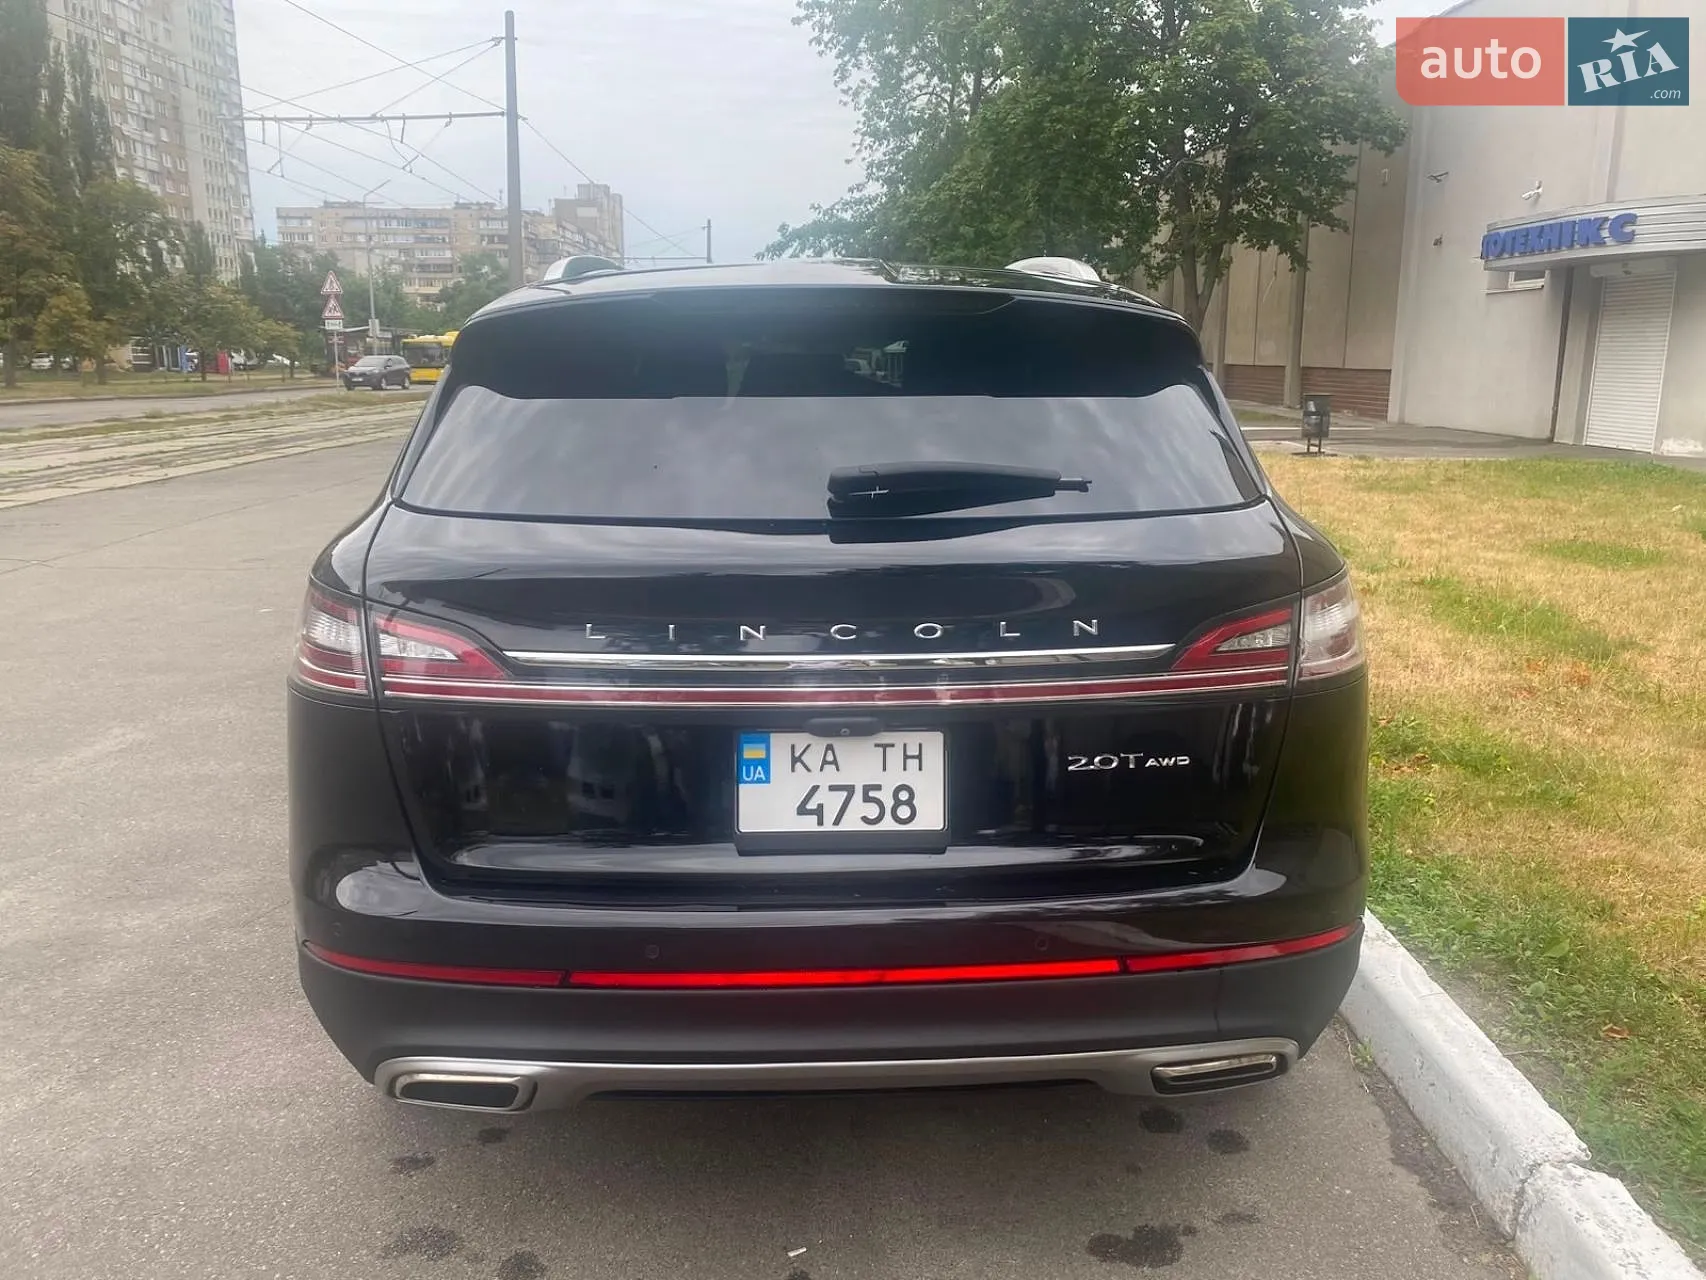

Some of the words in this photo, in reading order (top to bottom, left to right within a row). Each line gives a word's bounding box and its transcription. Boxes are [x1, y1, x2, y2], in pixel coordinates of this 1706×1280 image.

[585, 619, 1099, 641] LINCOLN
[790, 743, 840, 773] KA
[874, 742, 923, 772] TH
[1145, 756, 1190, 767] AWD
[742, 766, 766, 781] UA
[796, 783, 917, 826] 4758
